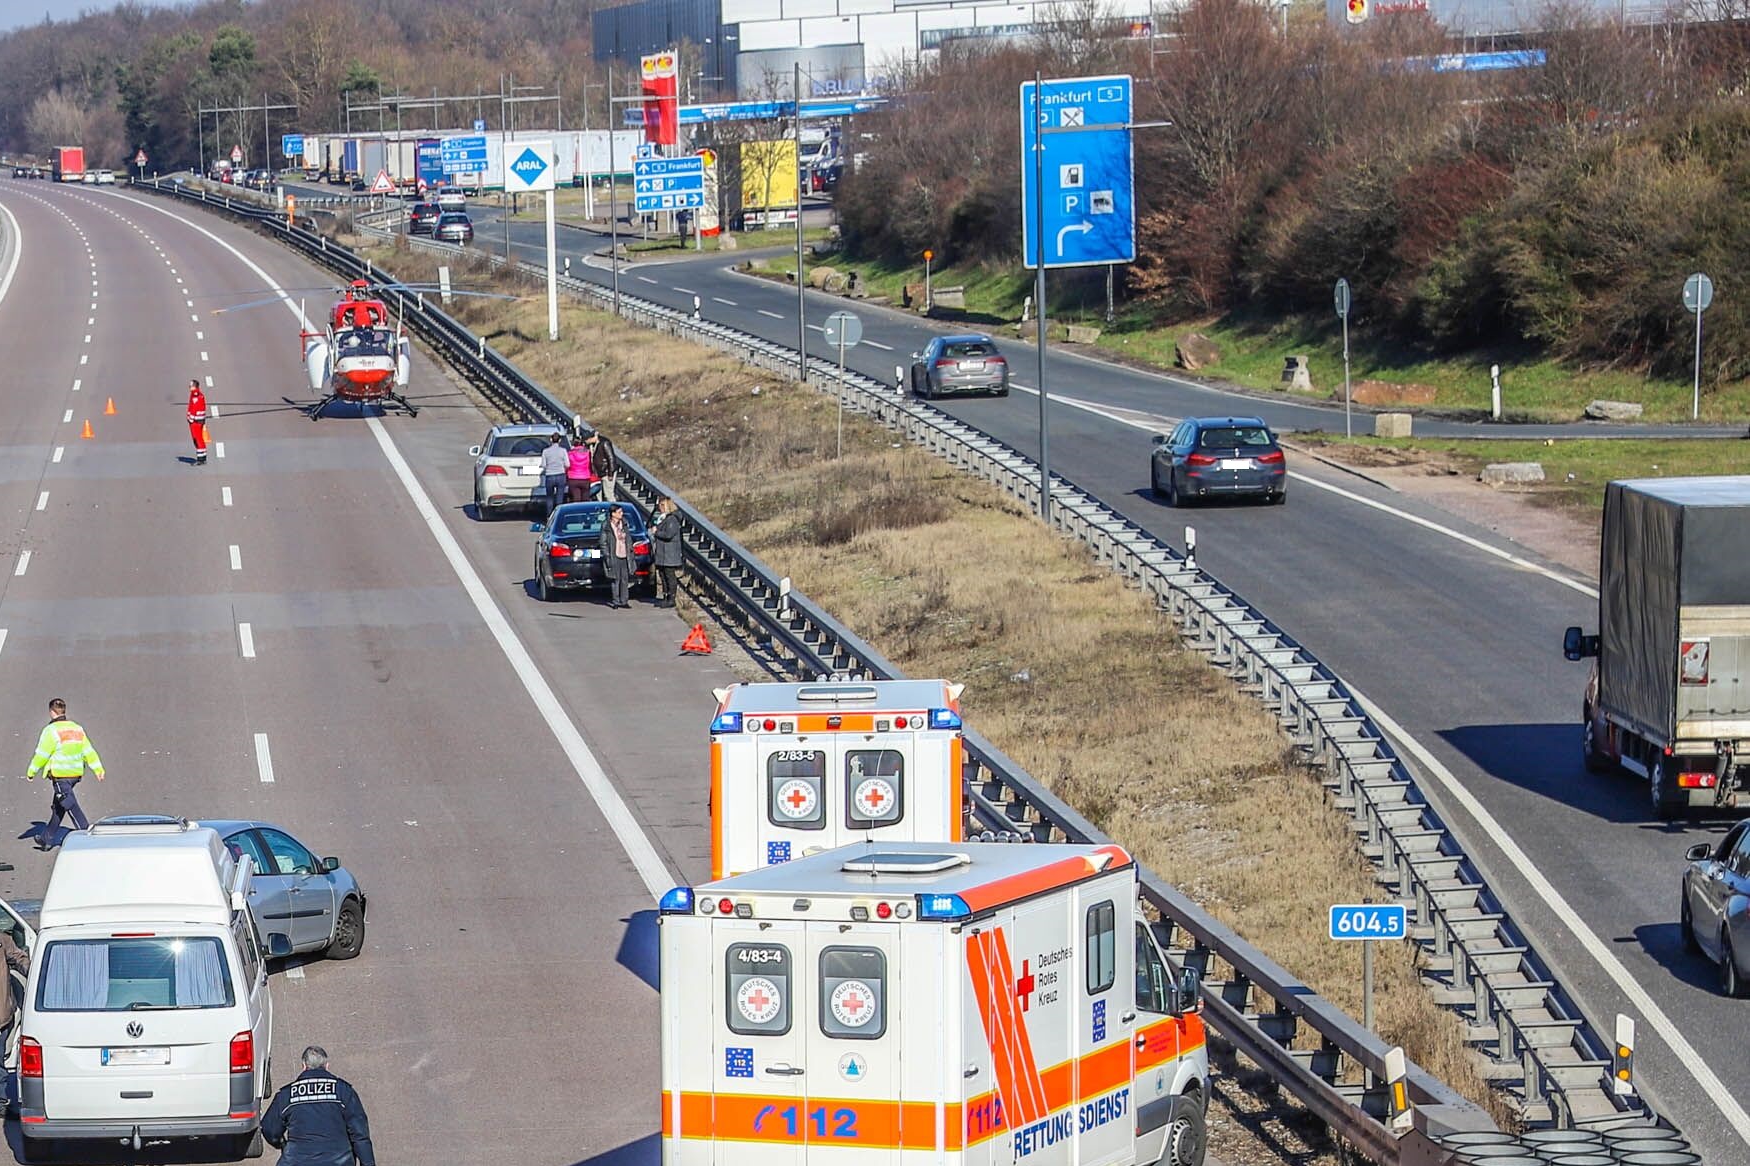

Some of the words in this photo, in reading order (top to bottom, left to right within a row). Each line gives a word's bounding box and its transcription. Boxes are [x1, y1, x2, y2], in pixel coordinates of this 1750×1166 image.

[1107, 89, 1114, 99] 5
[516, 160, 542, 170] ARAL
[668, 162, 700, 170] Frankfurt
[1066, 196, 1078, 213] P
[777, 751, 815, 761] 2/83-5
[780, 782, 813, 796] DEUTSCHES
[1338, 912, 1398, 935] 604,5
[738, 950, 782, 963] 4/83-4
[1038, 946, 1073, 968] Deutsches
[1038, 971, 1057, 987] Rotes
[741, 980, 776, 997] DEUTSCHES
[835, 984, 871, 1000] DEUTSCHES
[1038, 989, 1057, 1007] Kreuz
[740, 1000, 757, 1020] ROTES
[760, 1001, 778, 1020] KREUZ
[834, 1004, 851, 1023] ROTES
[855, 1005, 872, 1023] KREUZ
[734, 1059, 746, 1067] 112
[290, 1082, 337, 1097] POLIZEI
[780, 1106, 858, 1138] 112
[976, 1098, 1001, 1135] 112
